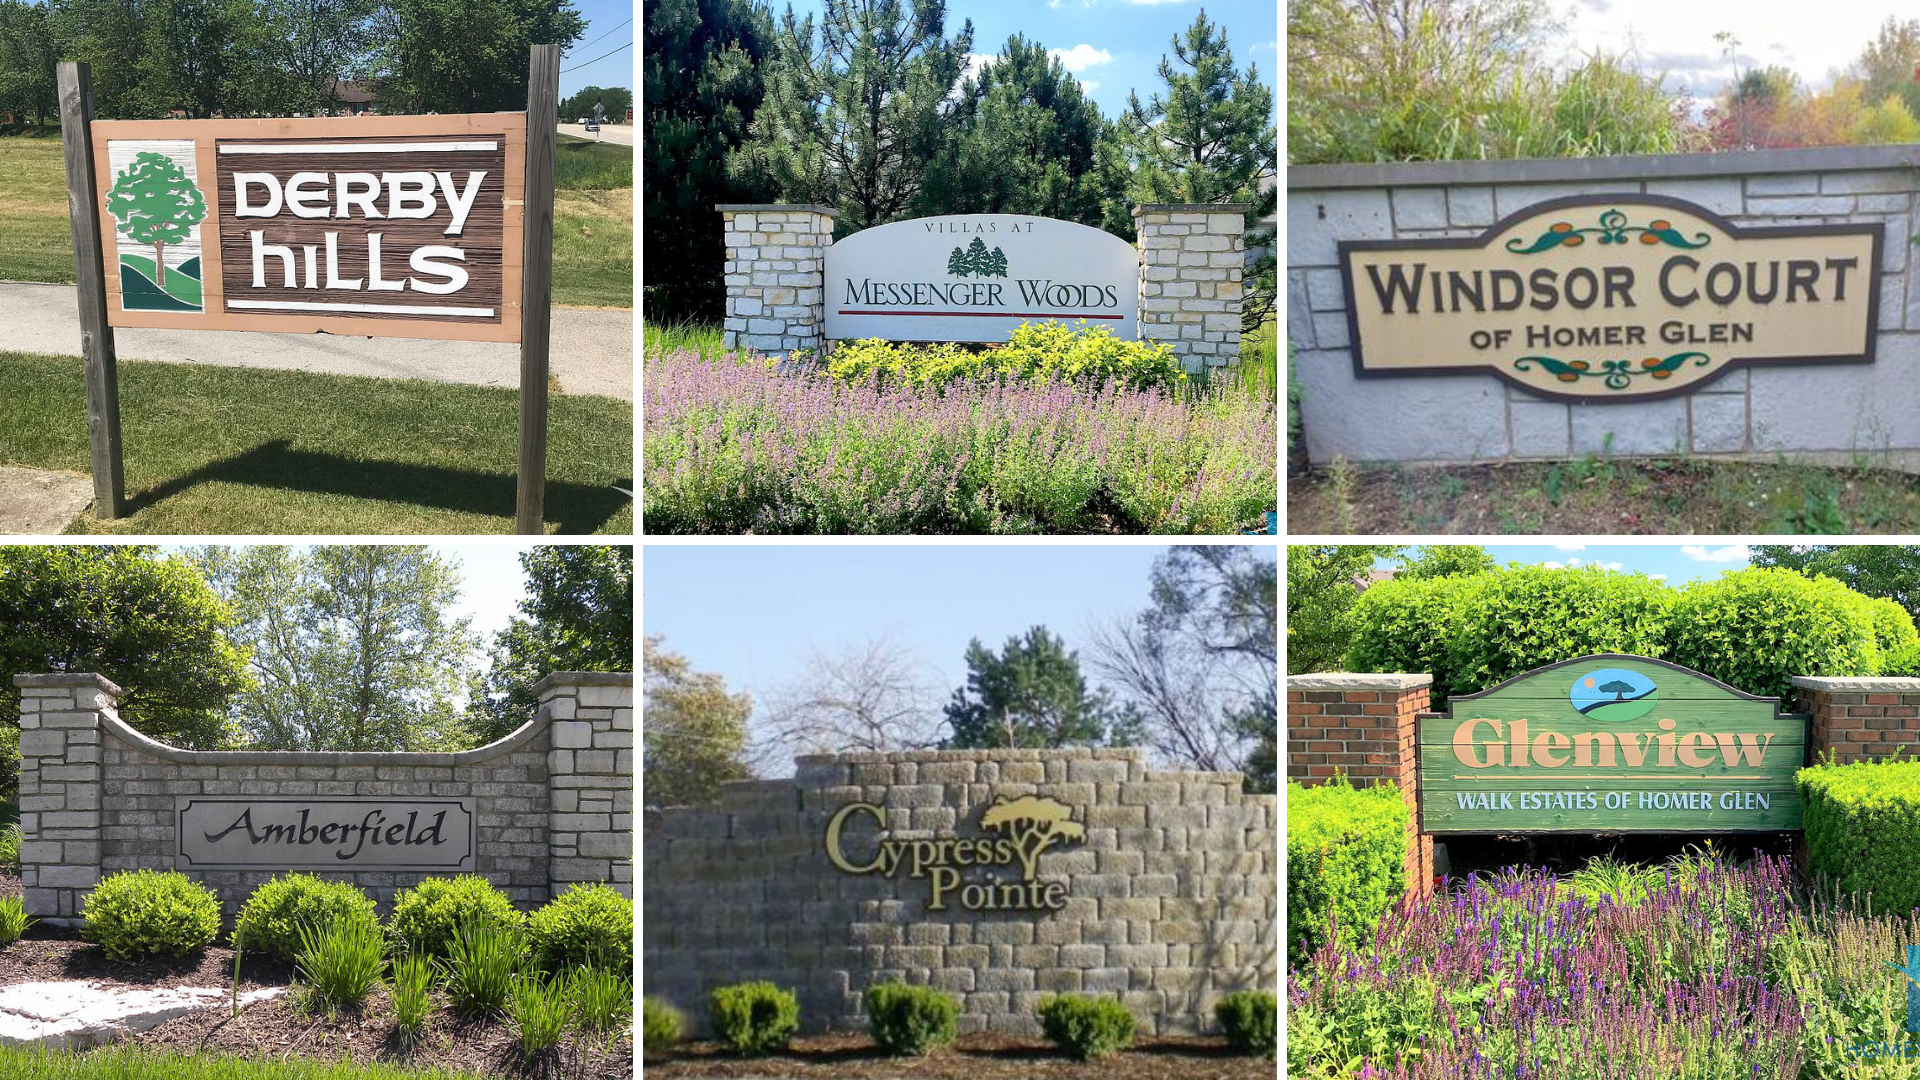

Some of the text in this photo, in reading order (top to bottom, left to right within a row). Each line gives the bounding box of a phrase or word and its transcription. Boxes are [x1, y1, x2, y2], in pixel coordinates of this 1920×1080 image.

[232, 170, 488, 236] DERBY
[924, 221, 1034, 233] VILLAS AT
[843, 278, 1118, 308] MESSENGER WOODS
[1469, 321, 1754, 350] OF HOMER GLEN
[1452, 718, 1775, 768] Glenview
[1456, 791, 1771, 811] WALK ESTATES OF HOMER GLEN
[204, 806, 448, 860] Amberfield
[825, 802, 1013, 877] Cypress
[928, 868, 1068, 911] Pointe
